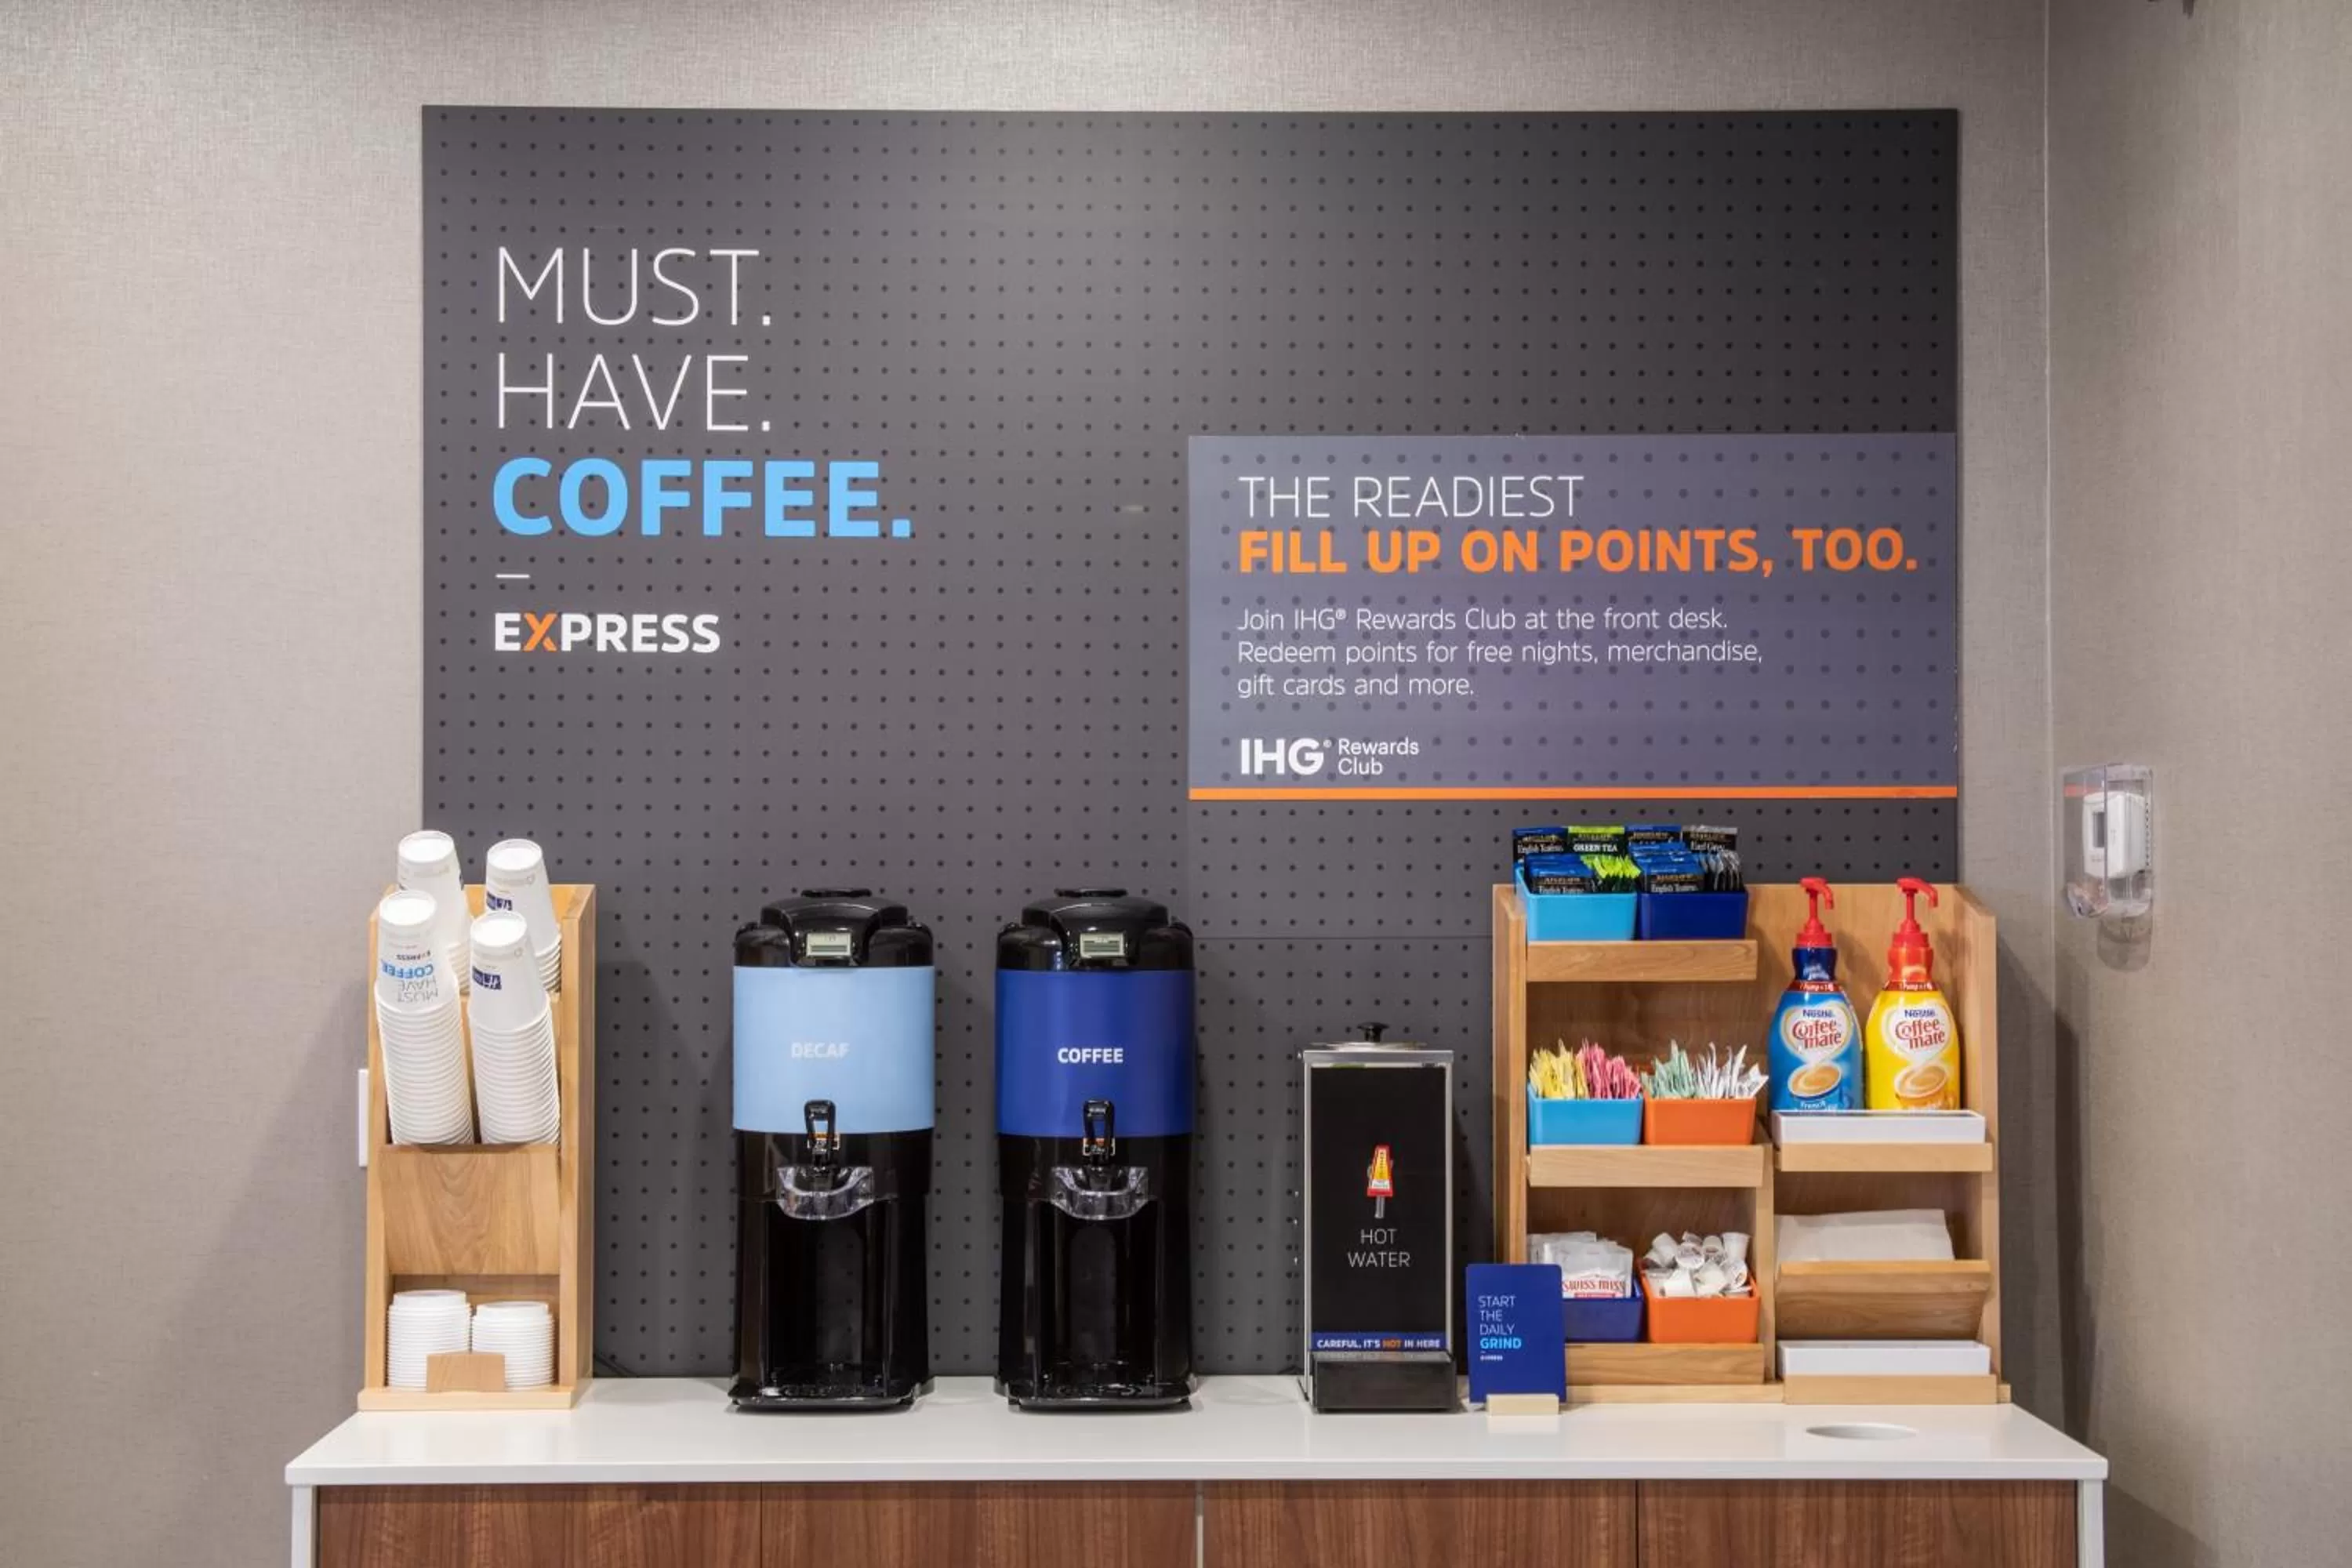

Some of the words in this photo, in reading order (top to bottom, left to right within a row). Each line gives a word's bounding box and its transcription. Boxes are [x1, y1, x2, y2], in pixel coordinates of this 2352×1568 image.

[499, 247, 771, 326] MUST.
[499, 353, 771, 430] HAVE.
[493, 457, 911, 537] COFFEE.
[1238, 476, 1330, 518] THE
[1354, 475, 1584, 518] READIEST
[1239, 530, 1347, 573] FILL
[1368, 530, 1441, 572] UP
[1461, 529, 1538, 572] ON
[1559, 528, 1773, 578] POINTS,
[1791, 528, 1918, 572] TOO.
[1238, 608, 1283, 630] Join
[1356, 608, 1456, 630] Rewards
[1465, 608, 1515, 630] Club
[1525, 610, 1548, 630] at
[1556, 608, 1595, 630] the
[1604, 608, 1660, 630] front
[1669, 608, 1727, 630] desk.
[495, 612, 720, 653] EXPRESS
[1238, 641, 1335, 662] Redeem
[1345, 642, 1417, 665] points
[1426, 641, 1458, 662] for
[1467, 641, 1512, 662] free
[1522, 640, 1598, 665] nights,
[1608, 640, 1763, 663] merchandise,
[1237, 675, 1275, 699] gift
[1283, 674, 1346, 695] cards
[1354, 674, 1399, 695] and
[1409, 677, 1474, 695] more.
[1338, 736, 1420, 755] Rewards
[1338, 757, 1384, 775] Club
[1602, 844, 1617, 852] TEA
[1792, 1019, 1838, 1040] Coffee
[1895, 1019, 1940, 1040] Coffee
[1804, 1033, 1842, 1049] mate
[1908, 1031, 1945, 1049] mate
[791, 1043, 850, 1058] DECAF
[1058, 1047, 1123, 1064] COFFEE
[1360, 1229, 1398, 1245] HOT
[1348, 1251, 1410, 1268] WATER
[1478, 1295, 1516, 1308] START
[1480, 1309, 1503, 1322] THE
[1479, 1323, 1515, 1335] DAILY
[1382, 1338, 1402, 1348] HOT
[1404, 1338, 1414, 1348] IN
[1417, 1338, 1440, 1348] HERE
[1480, 1338, 1522, 1349] GRIND
